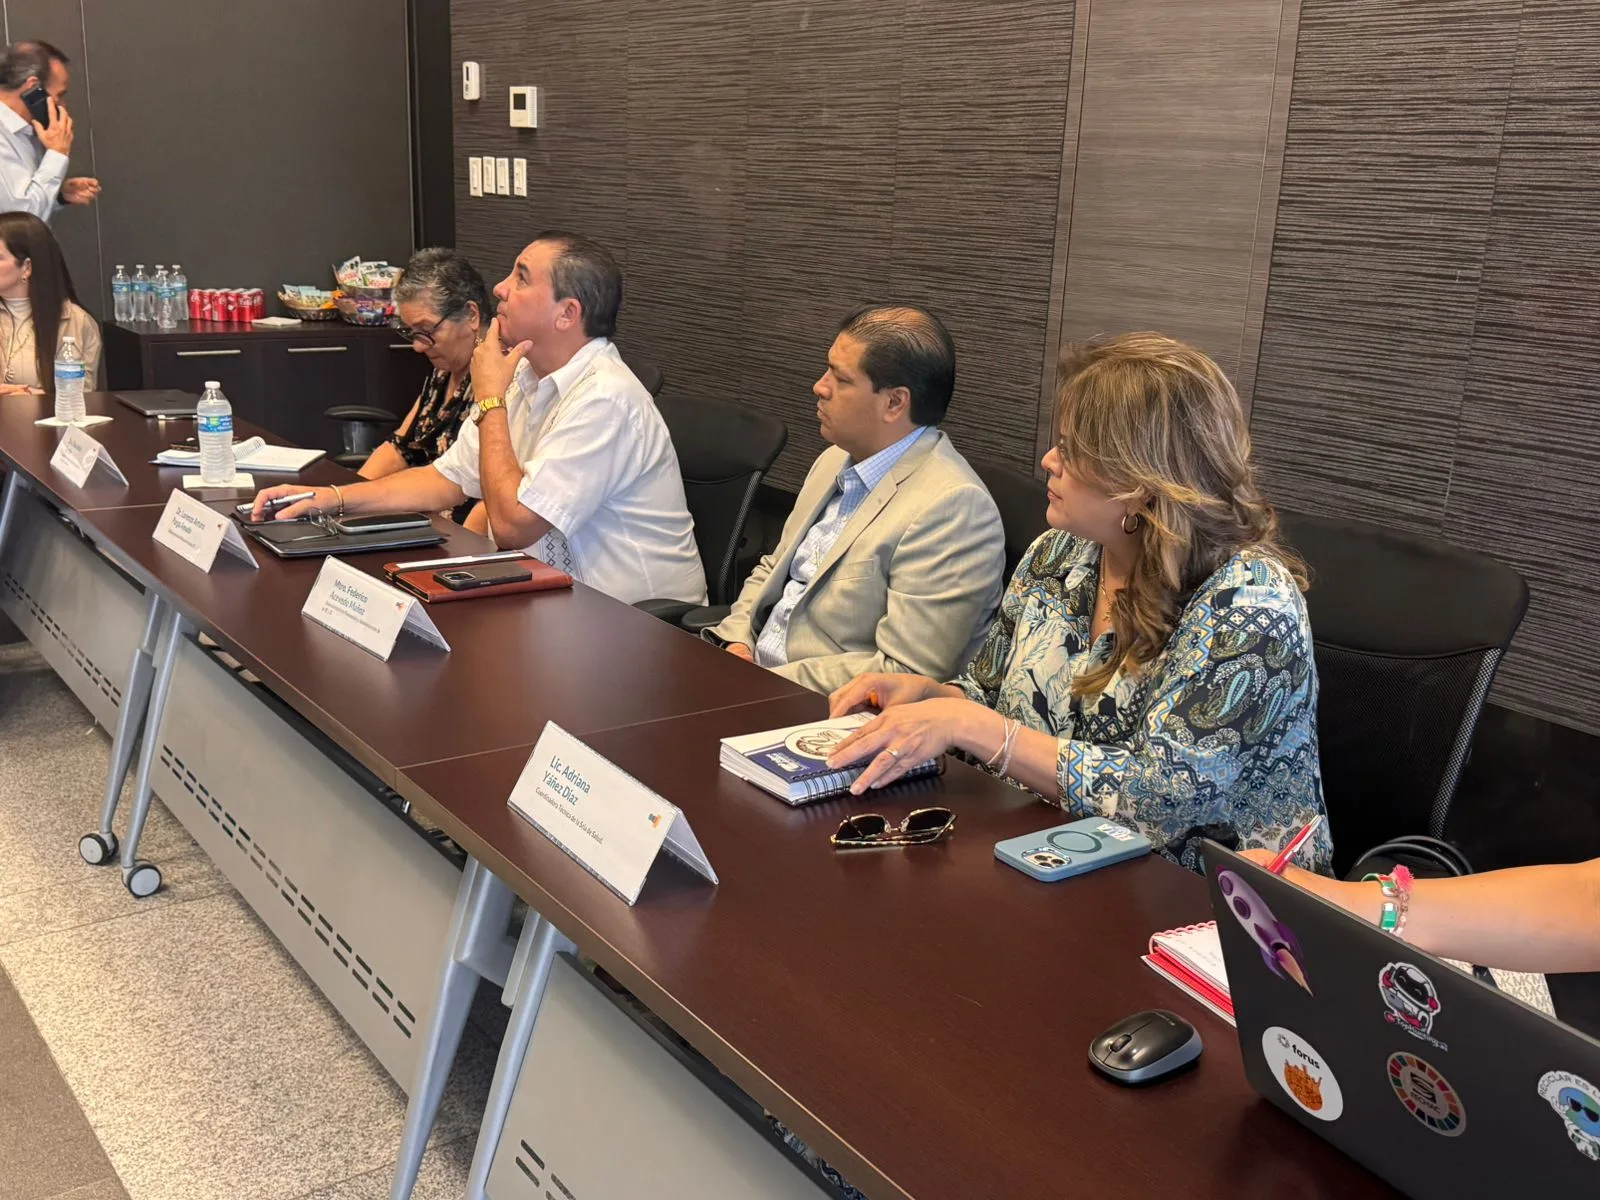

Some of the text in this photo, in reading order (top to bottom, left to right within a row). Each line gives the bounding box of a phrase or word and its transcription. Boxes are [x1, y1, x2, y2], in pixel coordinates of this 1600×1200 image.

[347, 585, 368, 603] Federico
[542, 770, 564, 795] Yáñez
[550, 755, 591, 794] Lic. Adriana
